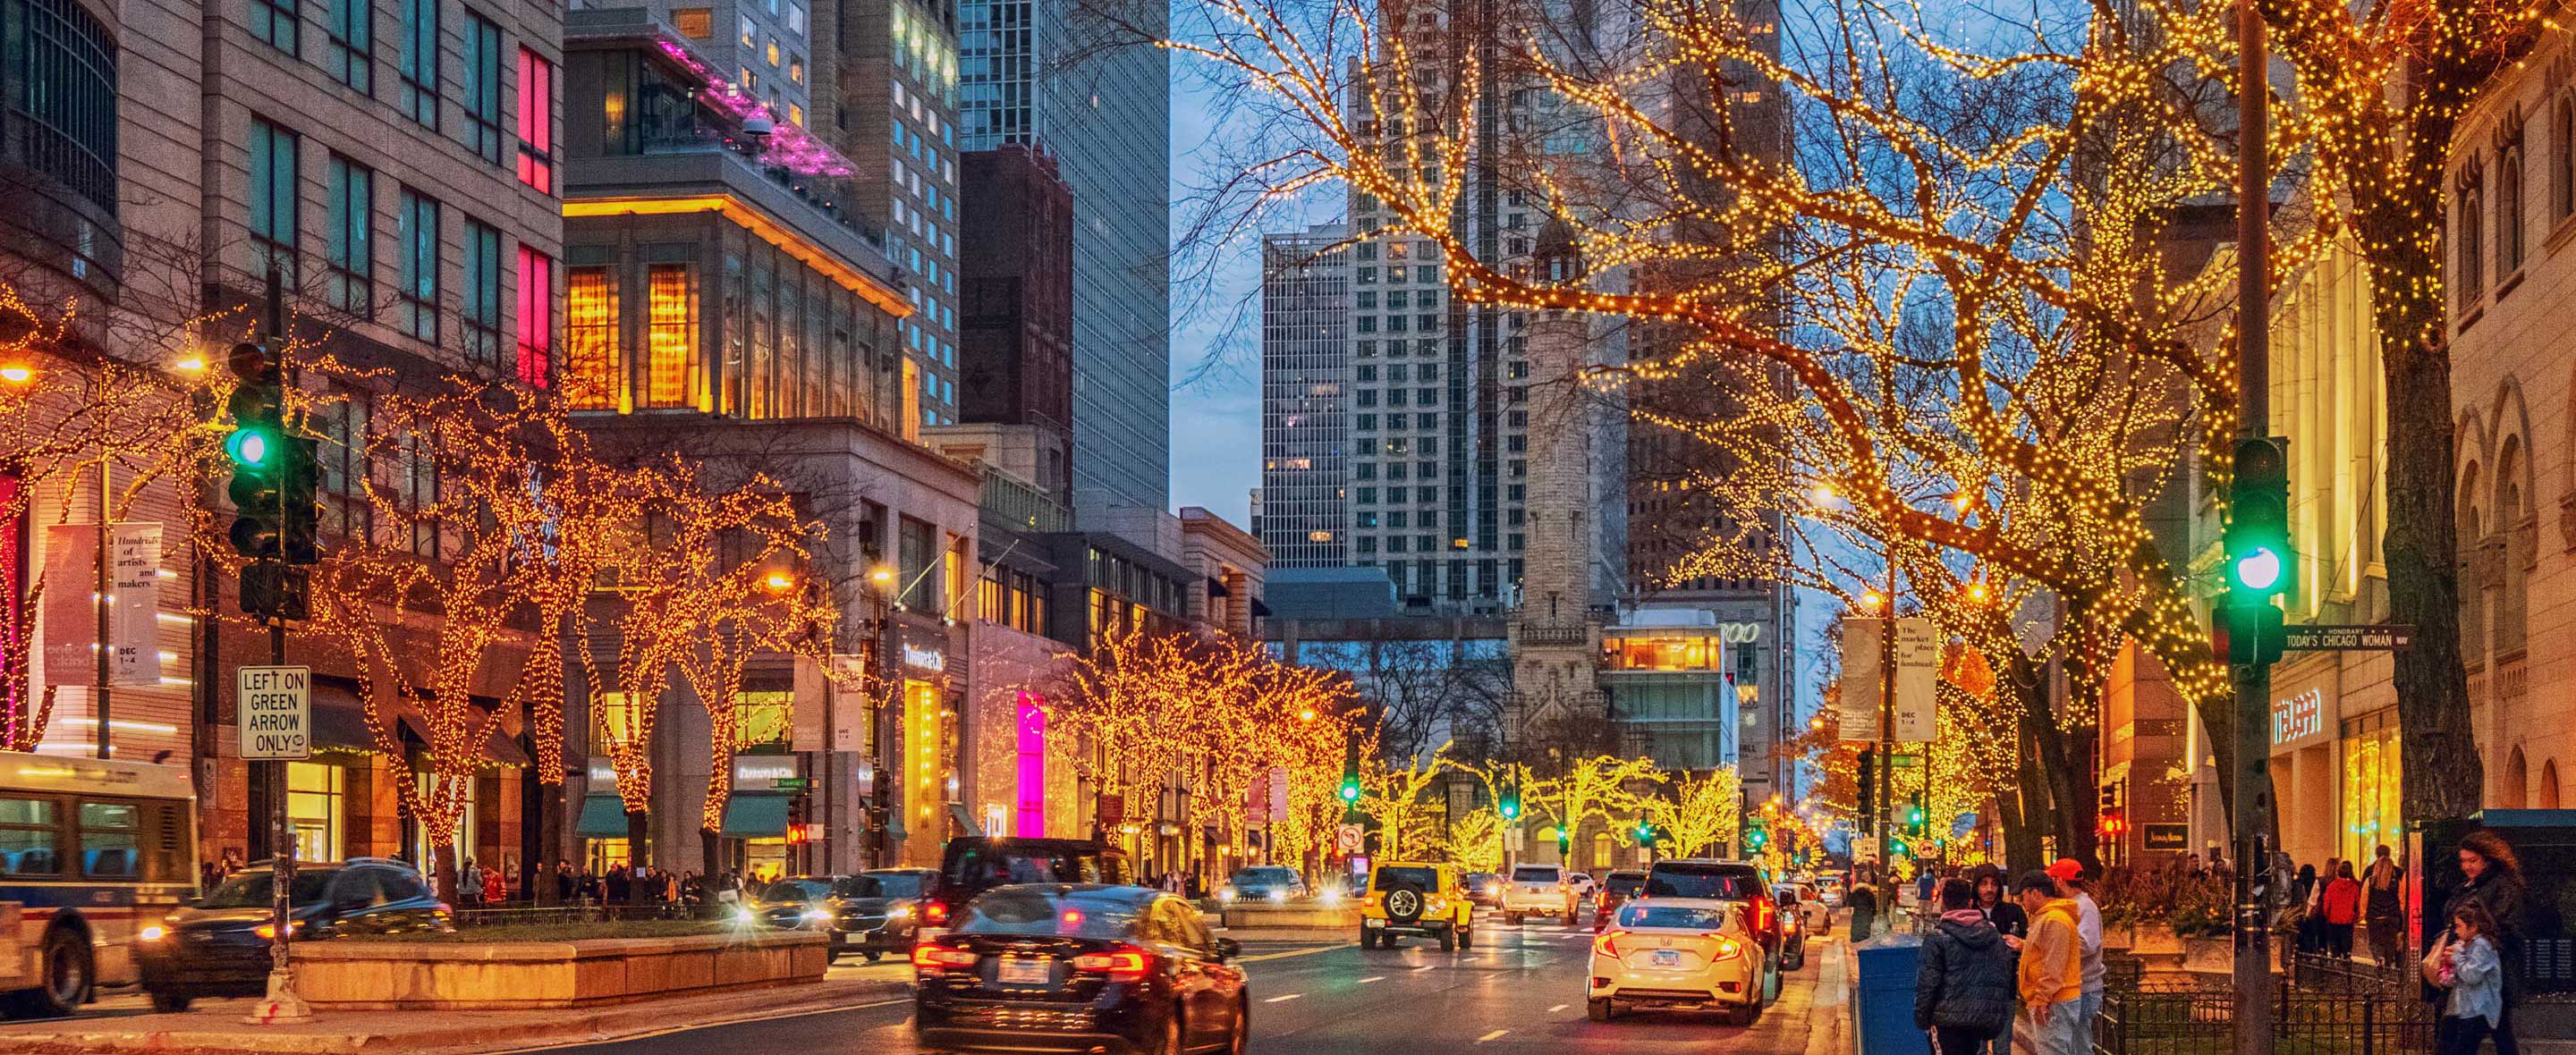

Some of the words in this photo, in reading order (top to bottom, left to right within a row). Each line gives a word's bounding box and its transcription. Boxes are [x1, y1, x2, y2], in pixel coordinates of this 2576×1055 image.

[118, 536, 159, 545] Hundreds
[123, 548, 134, 556] of
[140, 569, 156, 577] and
[118, 580, 151, 588] makers
[2287, 635, 2318, 647] TODAY'S
[2323, 635, 2357, 646] CHICAGO
[2361, 635, 2392, 646] WOMAN
[120, 647, 136, 655] DEC
[1915, 645, 1934, 653] place
[244, 672, 279, 690] LEFT
[285, 673, 304, 689] ON
[251, 694, 298, 711] GREEN
[250, 714, 300, 731] ARROW
[256, 735, 292, 751] ONLY
